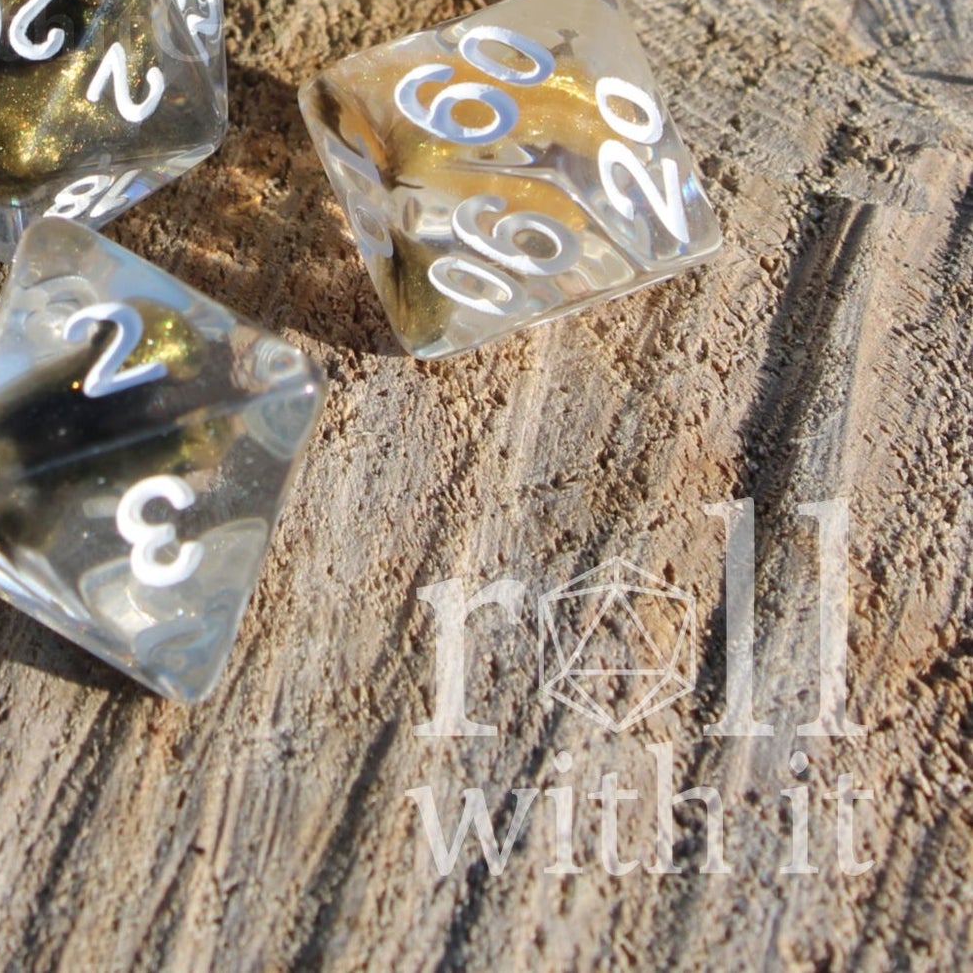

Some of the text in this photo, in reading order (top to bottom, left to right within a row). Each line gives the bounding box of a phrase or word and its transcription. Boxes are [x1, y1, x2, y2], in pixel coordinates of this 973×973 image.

[87, 42, 165, 122] 2
[394, 25, 557, 145] 60
[595, 76, 690, 244] 20
[64, 301, 168, 399] 2
[116, 474, 206, 588] 3
